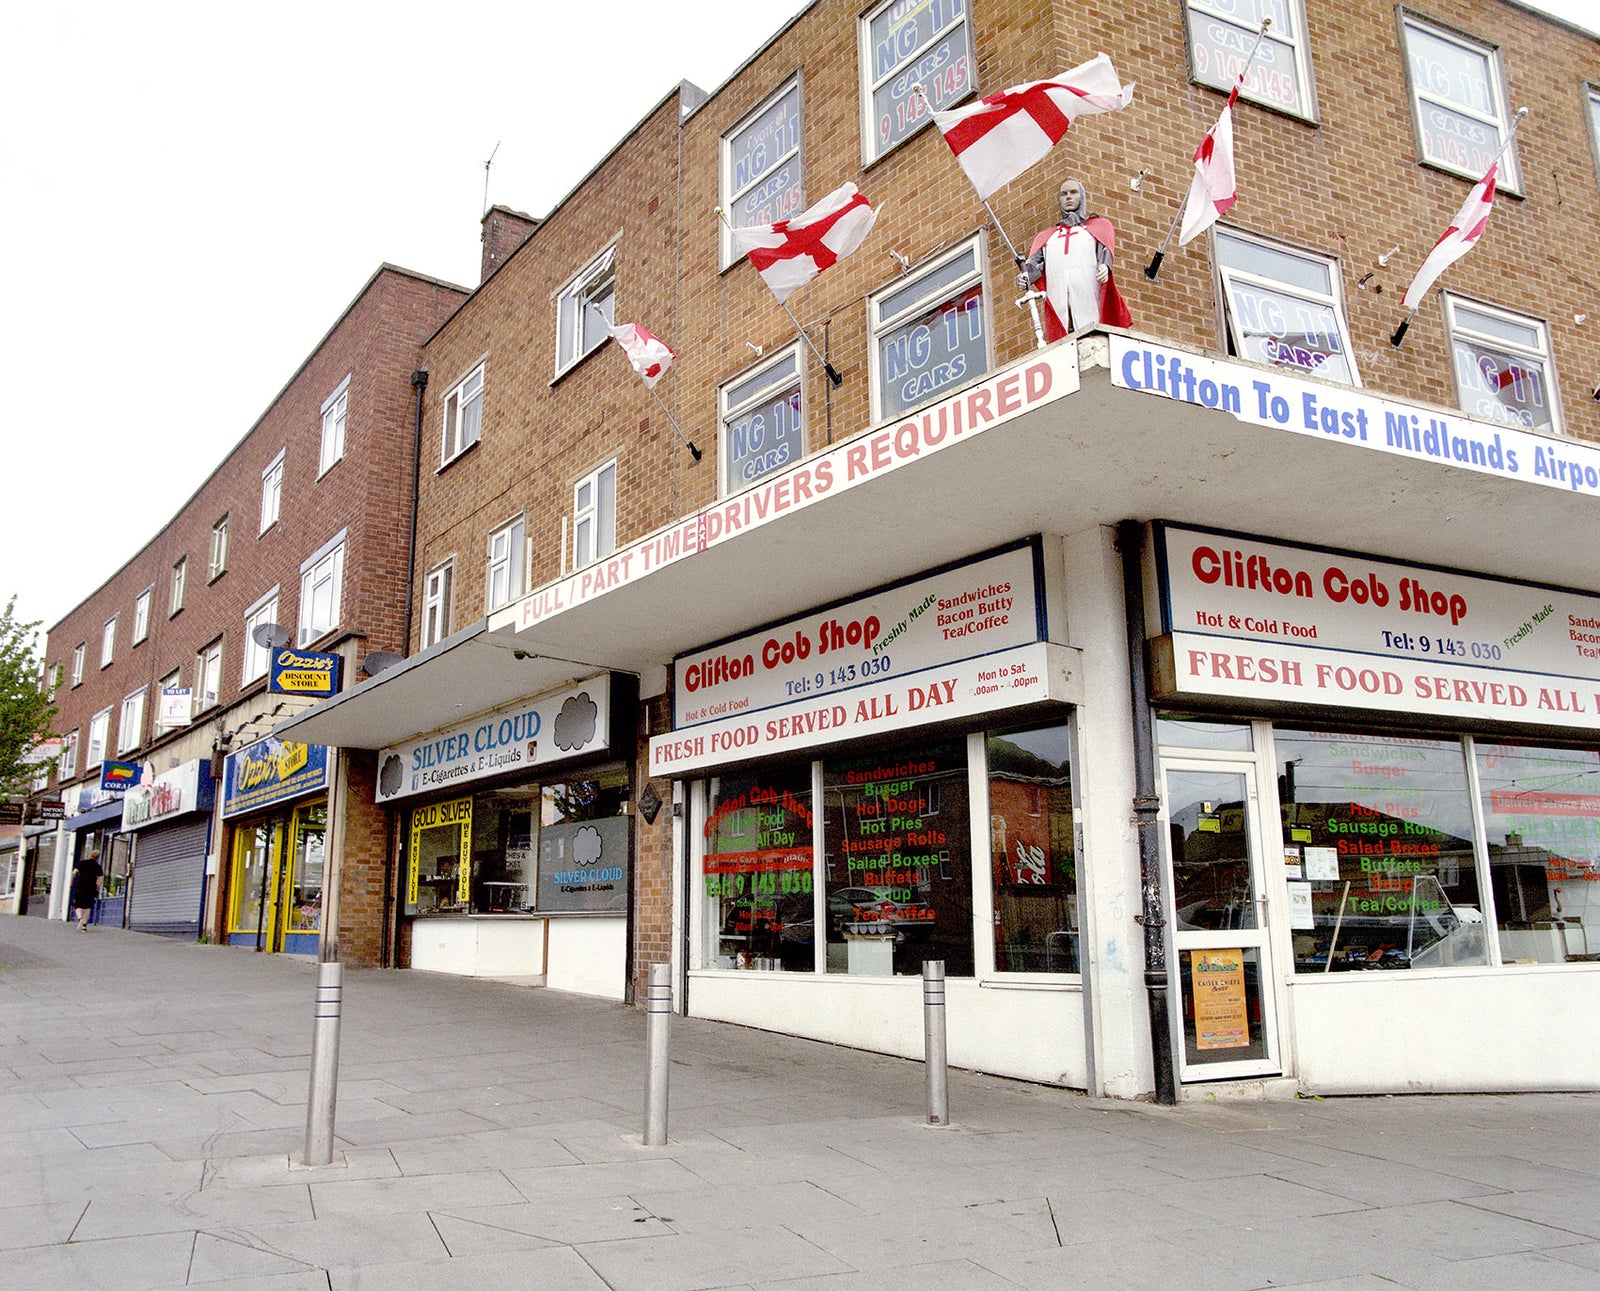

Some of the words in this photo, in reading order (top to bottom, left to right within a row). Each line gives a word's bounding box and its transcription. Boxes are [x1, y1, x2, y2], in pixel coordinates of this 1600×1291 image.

[876, 18, 918, 78] NG
[1208, 24, 1275, 62] CARS
[891, 42, 951, 100] CARS
[1194, 43, 1208, 73] 9
[1257, 65, 1294, 104] 145
[1410, 52, 1450, 97] NG
[1459, 71, 1492, 114] 11
[880, 114, 891, 144] 9
[934, 56, 967, 103] 145
[1430, 110, 1485, 144] CARS
[735, 143, 766, 192] NG
[774, 113, 799, 160] 11
[1436, 133, 1468, 168] 145
[745, 168, 789, 213] CARS
[776, 181, 801, 222] 145
[1232, 290, 1287, 338] NG
[1296, 307, 1341, 354] 11
[886, 325, 931, 383] NG
[943, 295, 982, 352] 11
[1261, 339, 1330, 373] CARS
[901, 354, 966, 402] CARS
[1456, 350, 1502, 396] NG
[1508, 362, 1544, 407] 11
[731, 414, 765, 464] NG
[774, 393, 801, 440] 11
[1121, 350, 1241, 414] Clifton
[1252, 380, 1290, 423] To
[1304, 392, 1368, 440] East
[1386, 411, 1519, 473] Midlands
[1534, 445, 1600, 490] Airpo
[1476, 400, 1535, 428] CARS
[743, 444, 790, 480] CARS
[523, 587, 564, 626] FULL
[581, 554, 633, 599] PART
[641, 523, 698, 571] TIME
[707, 460, 834, 542] DRIVERS
[847, 361, 1054, 481] REQUIRED
[937, 582, 1012, 612] Sandwiches
[1192, 546, 1313, 598] Clifton
[1323, 567, 1389, 608] Cob
[1399, 578, 1467, 626] Shop
[872, 620, 908, 657] Freshly
[908, 592, 937, 624] Made
[937, 607, 974, 628] Bacon
[978, 596, 1013, 619] Butty
[1196, 610, 1224, 628] Hot
[1228, 615, 1241, 630] &
[1245, 616, 1278, 634] Cold
[1283, 621, 1318, 639] Food
[942, 615, 1010, 641] Tea/Coffee
[1503, 620, 1534, 650] Freshly
[1531, 604, 1554, 626] Made
[277, 650, 334, 671] Ozzie's
[685, 654, 754, 693] Clifton
[762, 630, 811, 670] Cob
[819, 615, 880, 654] Shop
[1382, 631, 1414, 651] Tel:
[1419, 638, 1431, 653] 9
[1436, 638, 1467, 657] 143
[1470, 641, 1501, 661] 030
[285, 672, 329, 681] DISCOUNT
[290, 680, 319, 688] STORE
[786, 677, 811, 697] Tel:
[815, 674, 825, 689] 9
[829, 664, 857, 685] 143
[861, 655, 891, 677] 030
[977, 671, 997, 682] Mon
[999, 667, 1009, 677] to
[1010, 663, 1026, 675] Sat
[1187, 650, 1302, 687] FRESH
[1316, 664, 1404, 696] FOOD
[1414, 676, 1528, 708] SERVED
[1537, 688, 1586, 713] ALL
[654, 736, 705, 765] FRESH
[711, 725, 759, 753] FOOD
[766, 709, 847, 742] SERVED
[853, 695, 898, 723] ALL
[907, 678, 959, 712] DAY
[685, 710, 699, 722] Hot
[700, 708, 708, 718] &
[709, 701, 727, 716] Cold
[729, 697, 749, 712] Food
[411, 736, 470, 772] SILVER
[474, 711, 542, 753] CLOUD
[1328, 743, 1427, 761] Sandwiches
[238, 747, 278, 792] Ozzie's
[422, 764, 469, 785] E-Cigarettes
[470, 763, 477, 772] &
[478, 749, 522, 771] E-Liquids
[847, 761, 936, 784] Sandwiches
[1352, 761, 1408, 779] Burger
[104, 781, 132, 789] CORAL
[750, 786, 778, 805] Cob
[865, 780, 915, 797] Burger
[413, 806, 437, 828] GOLD
[440, 800, 471, 823] SILVER
[856, 801, 881, 816] Hot
[887, 798, 926, 814] Dogs
[1350, 802, 1380, 817] Hot
[1385, 802, 1419, 818] Pies
[1495, 795, 1539, 811] Delivery
[758, 810, 785, 827] Food
[860, 820, 886, 835] Hot
[892, 817, 923, 832] Pies
[1327, 818, 1398, 837] Sausage
[1404, 820, 1443, 836] Rolls
[757, 832, 770, 847] All
[774, 831, 795, 847] Day
[841, 837, 902, 853] Sausage
[907, 830, 946, 847] Rolls
[1337, 839, 1384, 855] Salad
[1390, 840, 1439, 855] Boxes
[553, 871, 587, 885] SILVER
[589, 868, 623, 882] CLOUD
[848, 855, 886, 871] Salad
[893, 853, 939, 867] Boxes
[1361, 857, 1421, 872] Buffets
[736, 875, 745, 895] 9
[751, 873, 776, 895] 143
[865, 870, 920, 886] Buffets
[1371, 875, 1413, 893] Soup
[874, 887, 911, 903] Soup
[1348, 896, 1440, 912] Tea/Coffee
[853, 905, 936, 922] Tea/Coffee
